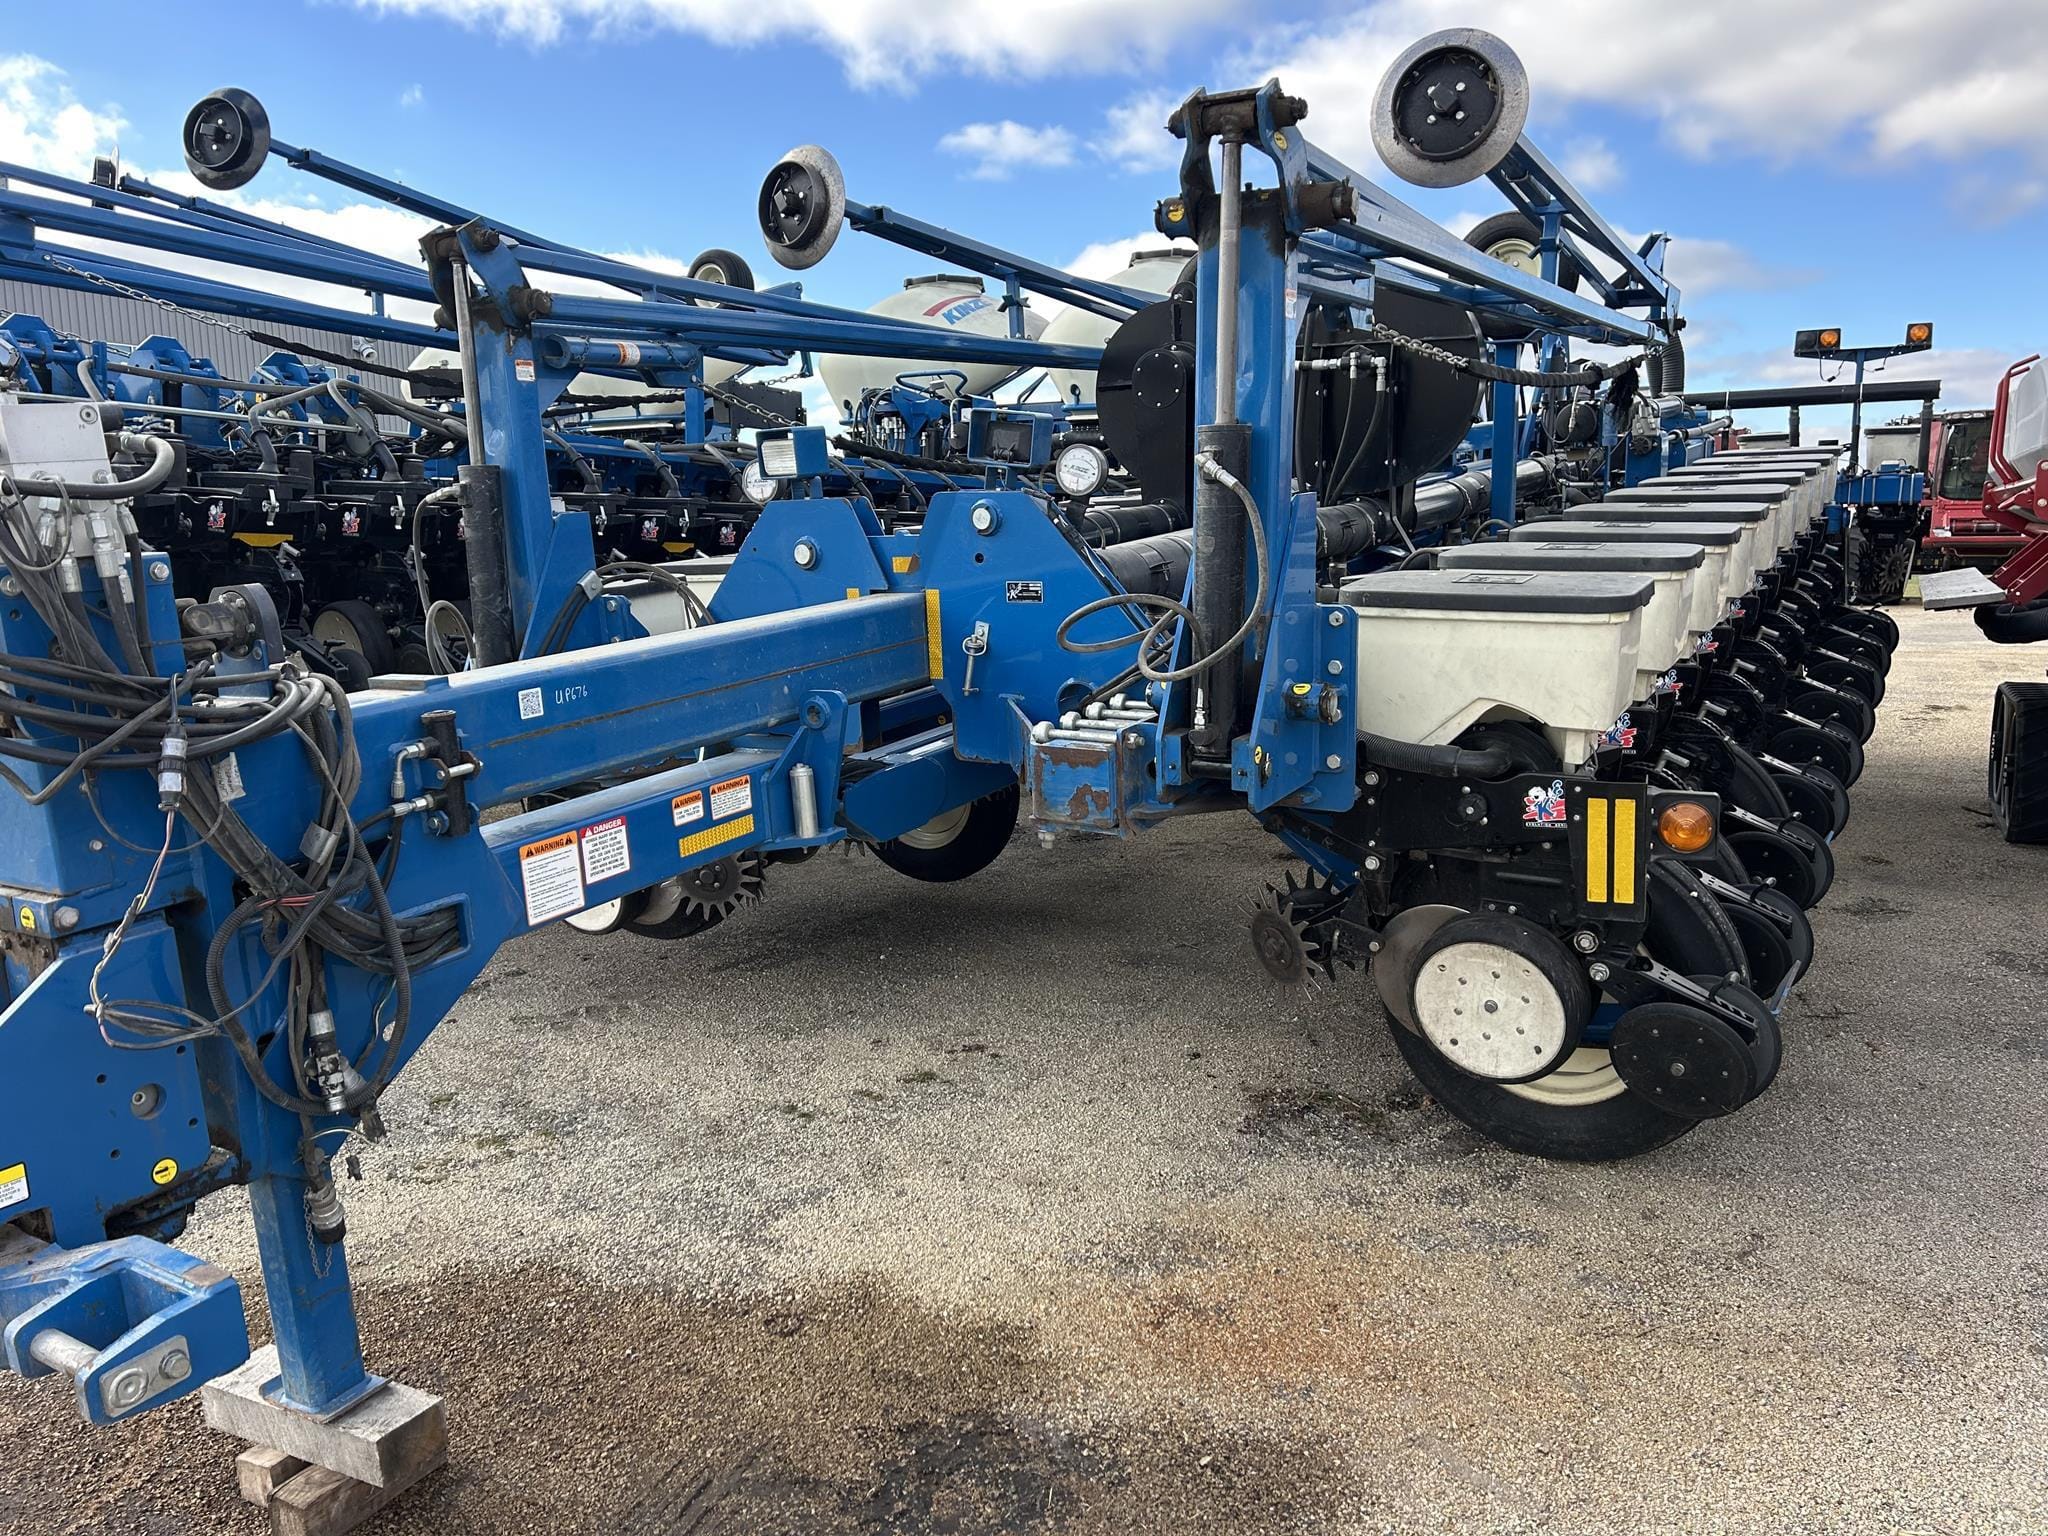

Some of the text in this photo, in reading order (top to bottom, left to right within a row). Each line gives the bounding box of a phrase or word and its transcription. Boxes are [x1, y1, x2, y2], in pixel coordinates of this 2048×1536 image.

[555, 685, 588, 704] UP676
[716, 779, 742, 791] WARNING
[593, 818, 622, 832] DANGER
[533, 838, 564, 854] WARNING
